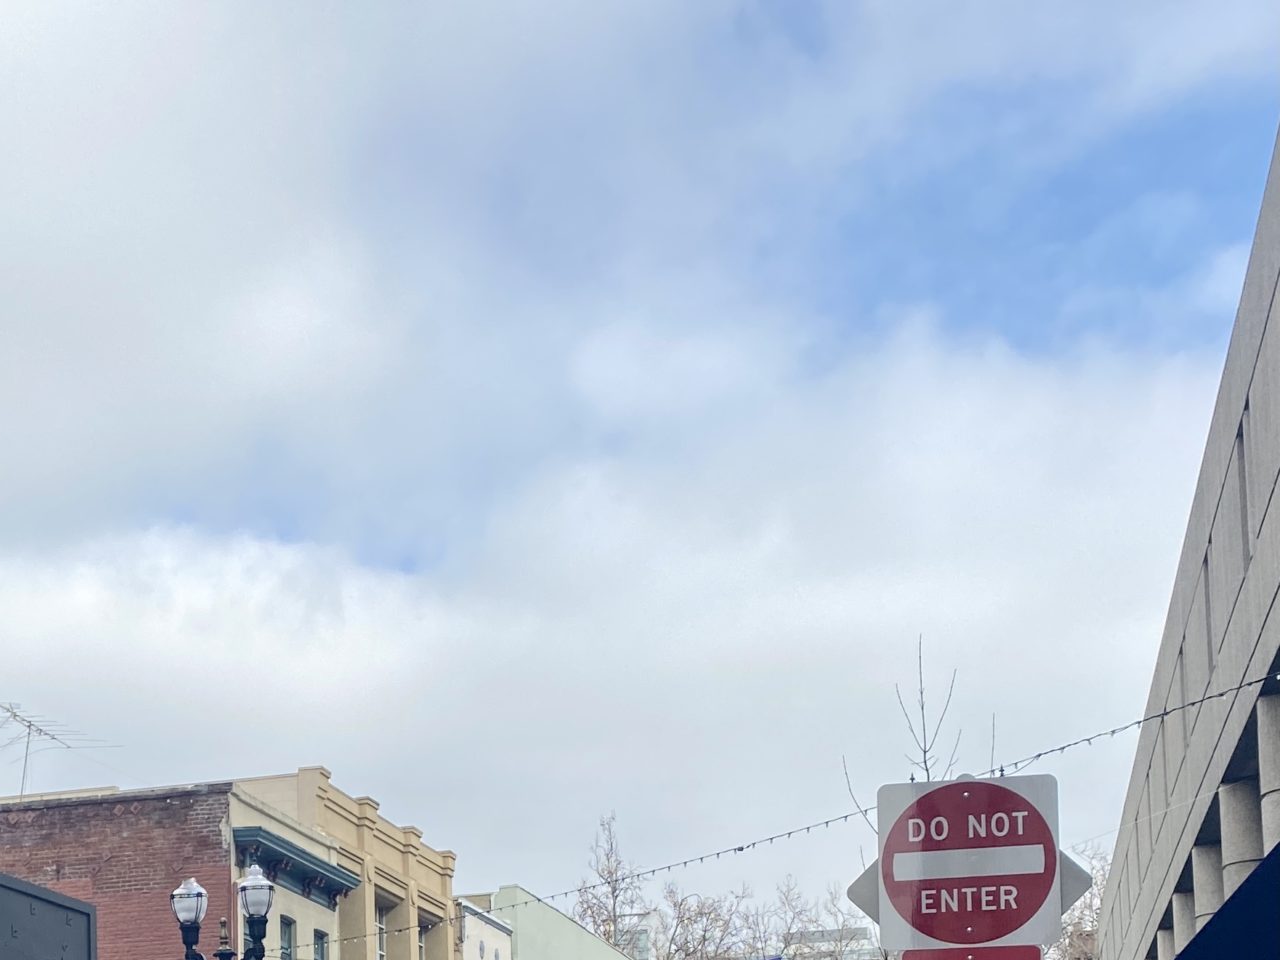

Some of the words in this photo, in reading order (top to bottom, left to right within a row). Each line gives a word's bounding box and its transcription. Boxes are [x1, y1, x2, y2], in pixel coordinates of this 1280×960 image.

[907, 816, 949, 842] DO
[968, 811, 1028, 838] NOT
[921, 885, 1018, 914] ENTER
